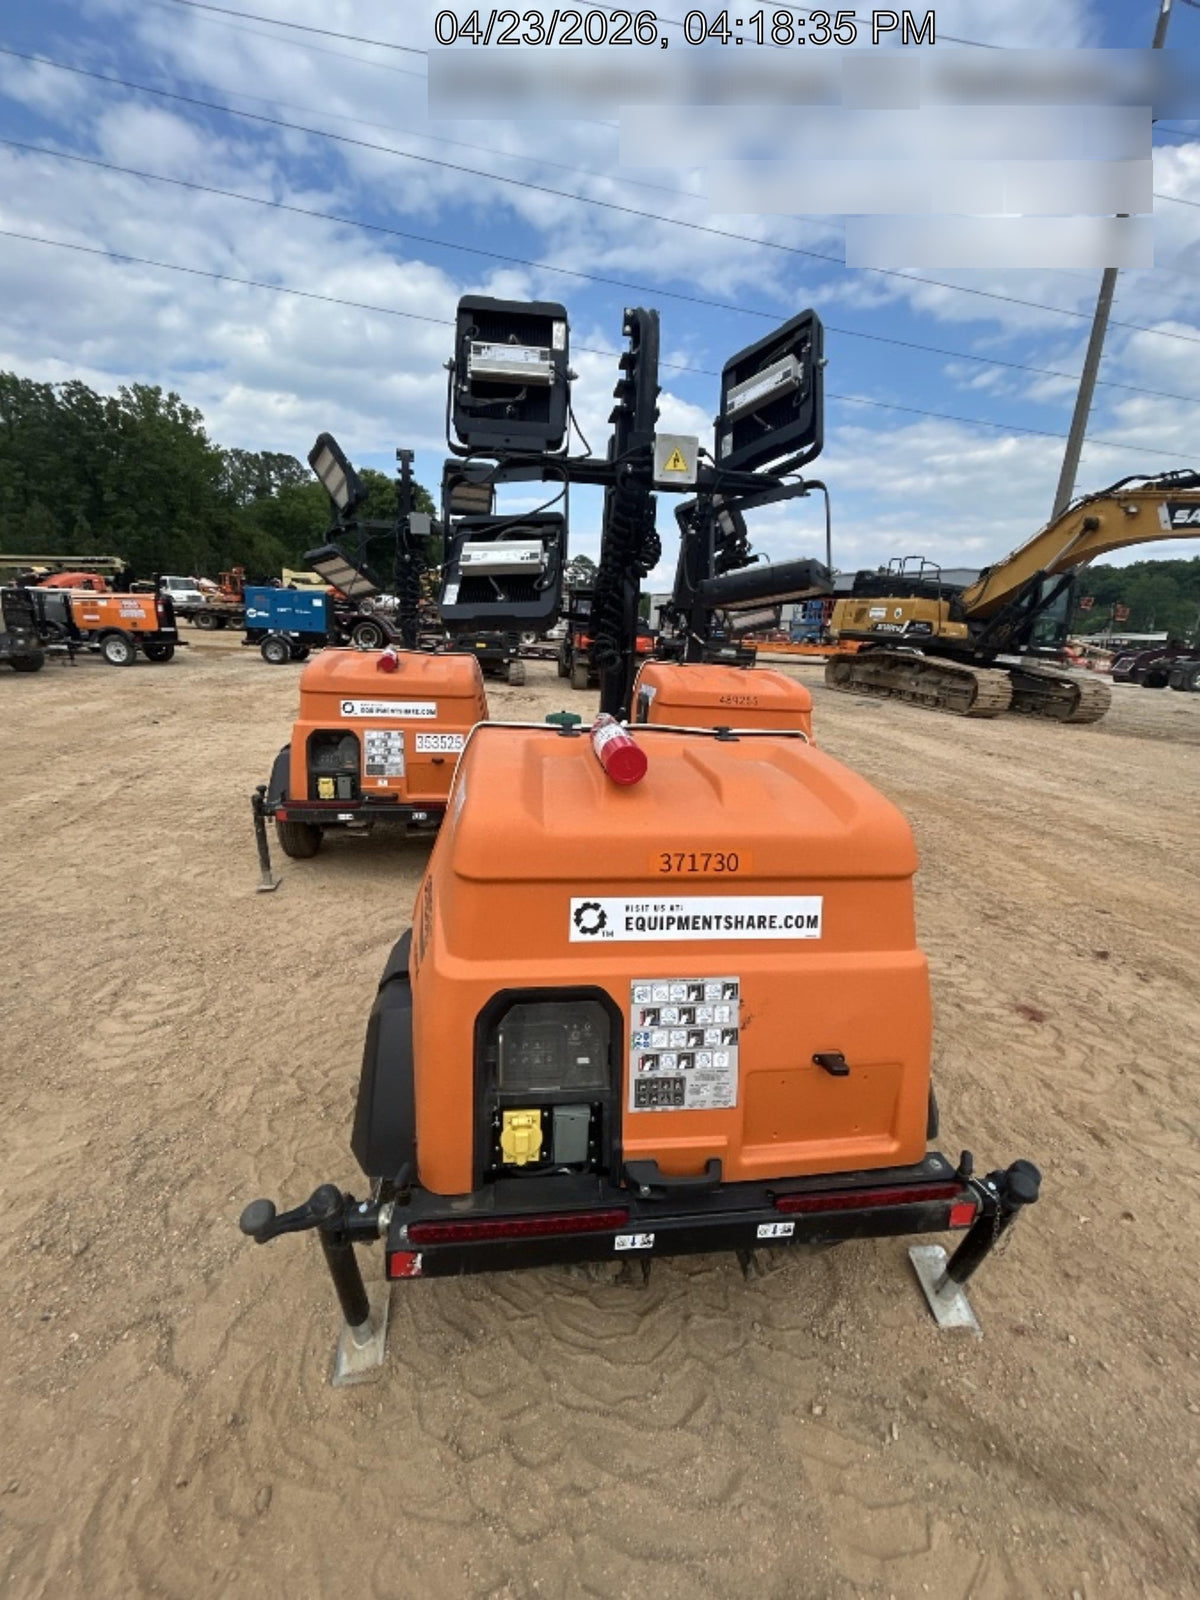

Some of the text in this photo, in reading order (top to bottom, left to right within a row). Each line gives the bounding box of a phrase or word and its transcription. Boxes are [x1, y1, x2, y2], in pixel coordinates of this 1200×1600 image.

[659, 852, 739, 873] 371730
[625, 904, 650, 912] VISIT
[654, 904, 666, 912] US
[624, 914, 819, 932] EQUIPMENTSHARE.COM
